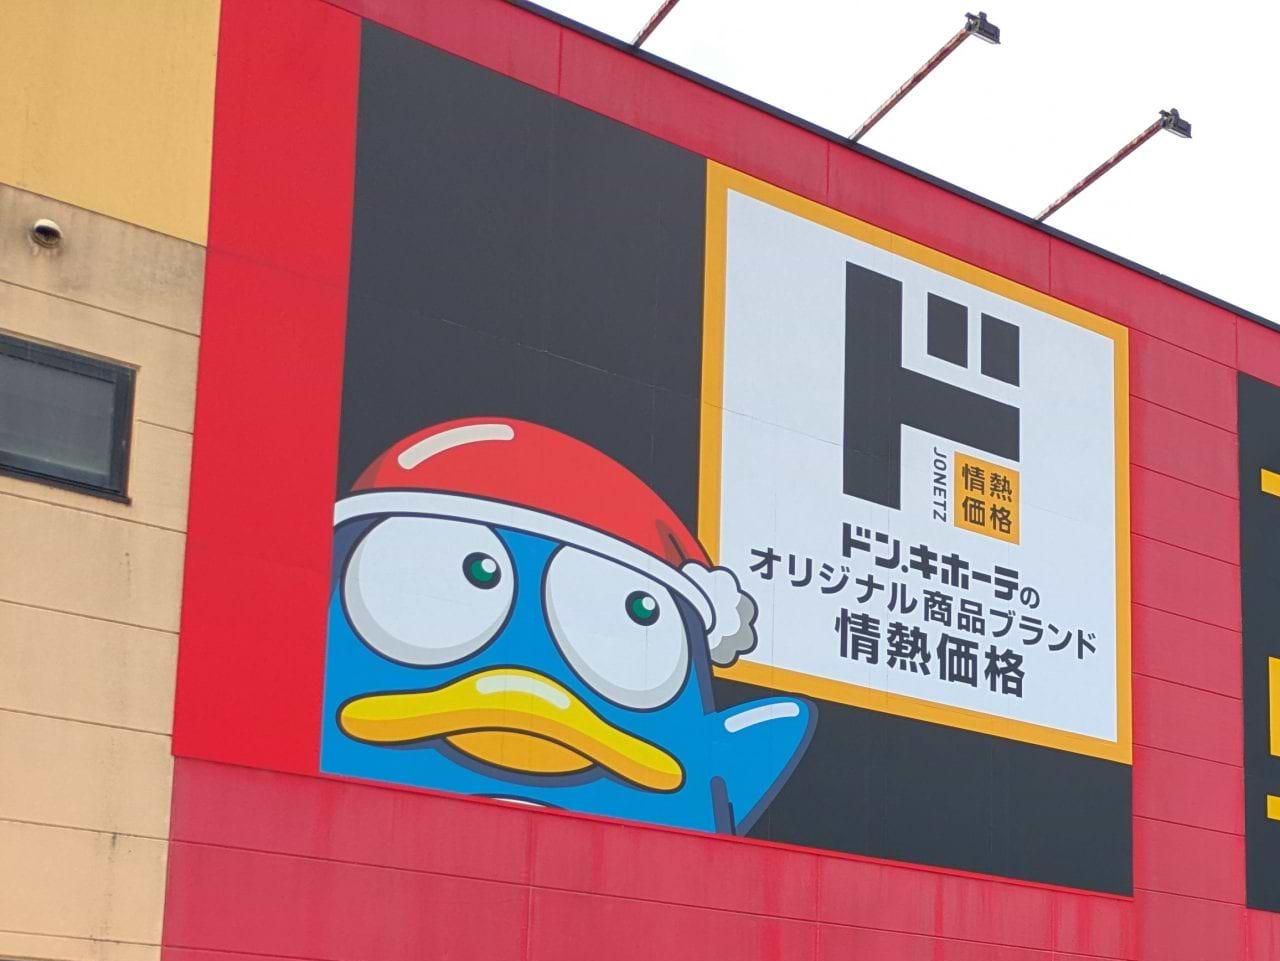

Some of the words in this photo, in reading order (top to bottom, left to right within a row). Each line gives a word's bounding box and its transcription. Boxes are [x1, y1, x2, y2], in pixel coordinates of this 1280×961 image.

[843, 261, 1020, 511] ド
[933, 446, 947, 523] JONETZ
[962, 463, 1013, 503] 情熱
[962, 496, 1013, 535] 価格
[749, 546, 1098, 660] オリジナル商品ブランド
[834, 607, 1026, 698] 情熱価格
